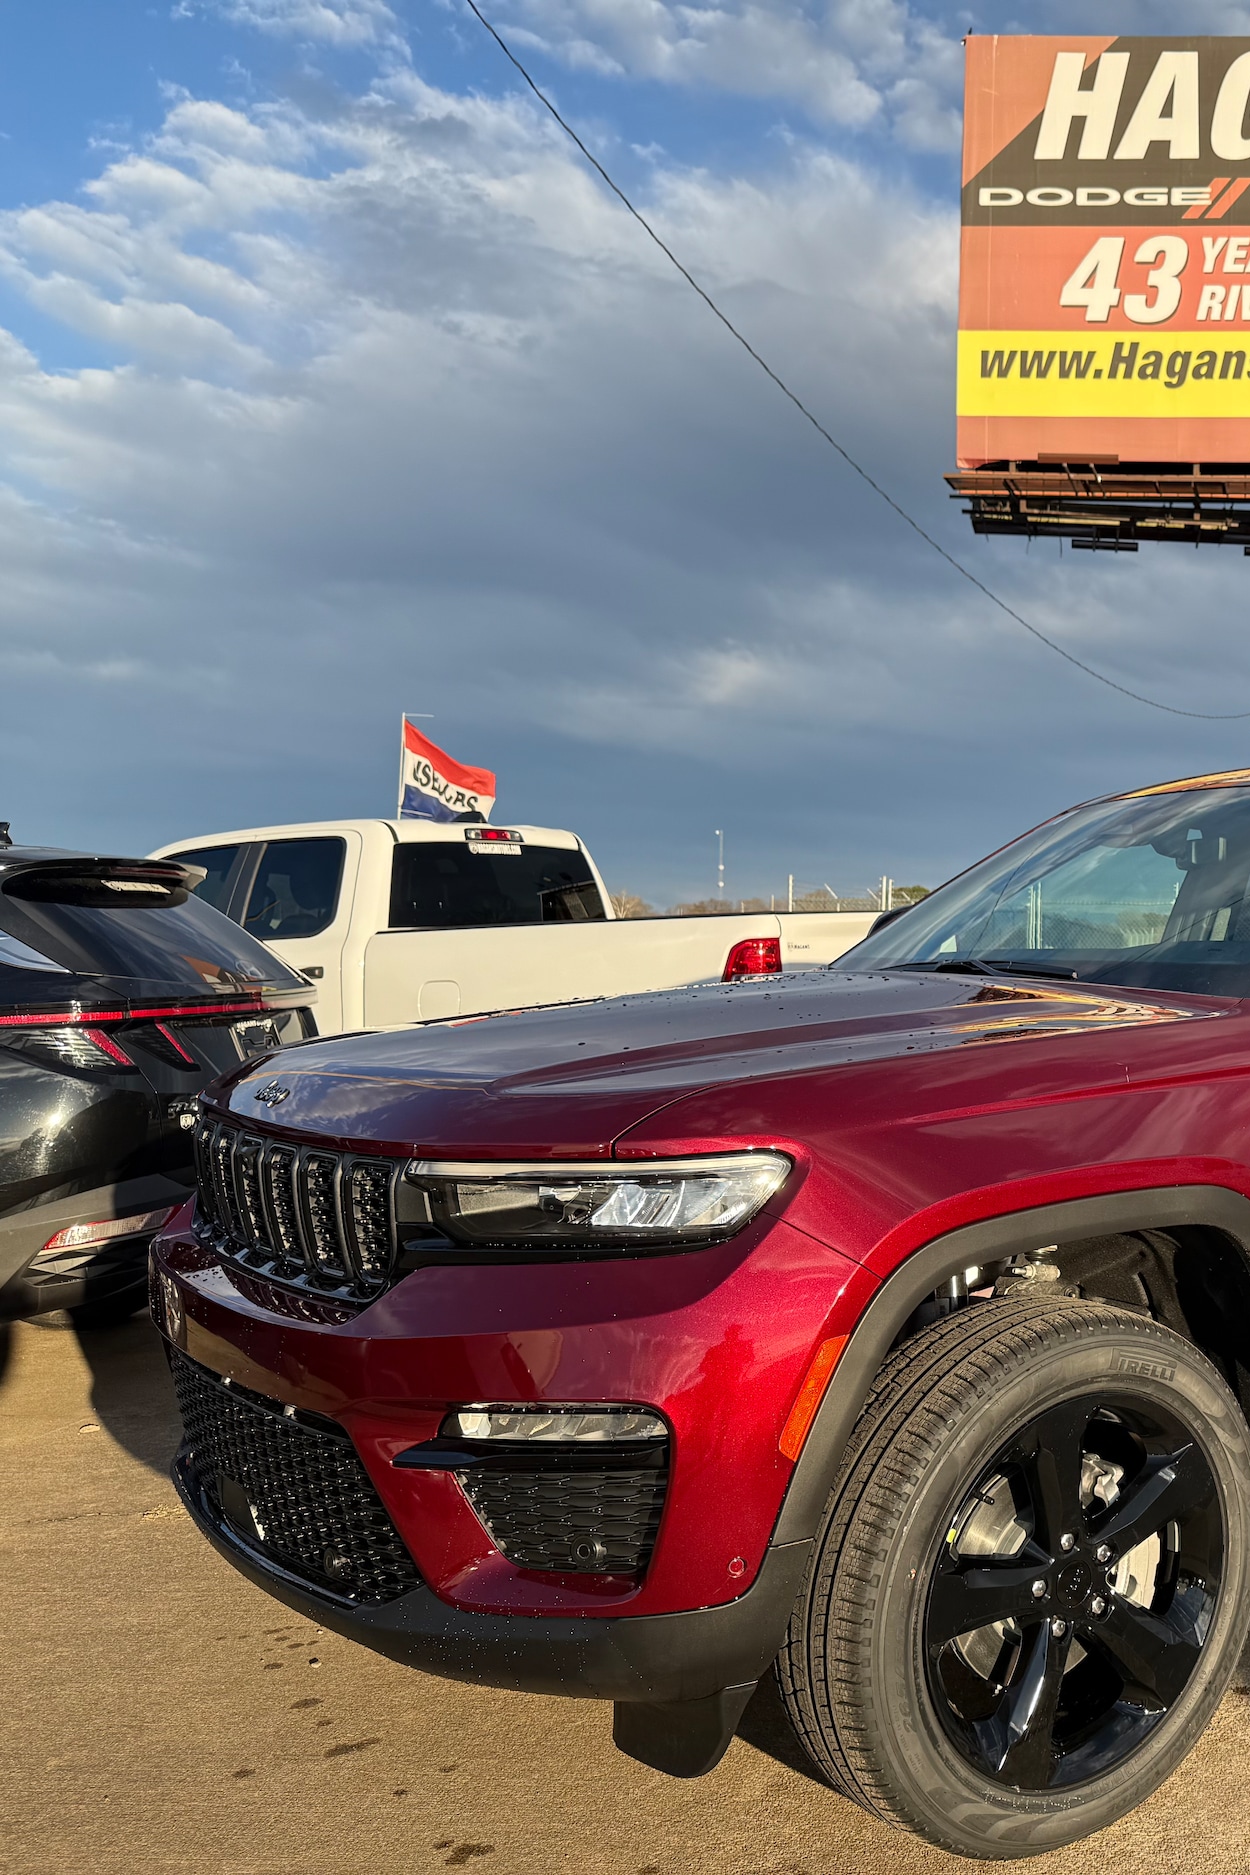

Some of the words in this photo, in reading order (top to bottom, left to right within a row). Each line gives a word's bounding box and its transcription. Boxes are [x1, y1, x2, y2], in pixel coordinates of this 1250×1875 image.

[978, 187, 1212, 207] DODGE
[1059, 235, 1189, 324] 43
[1109, 1347, 1178, 1382] PIRELLI
